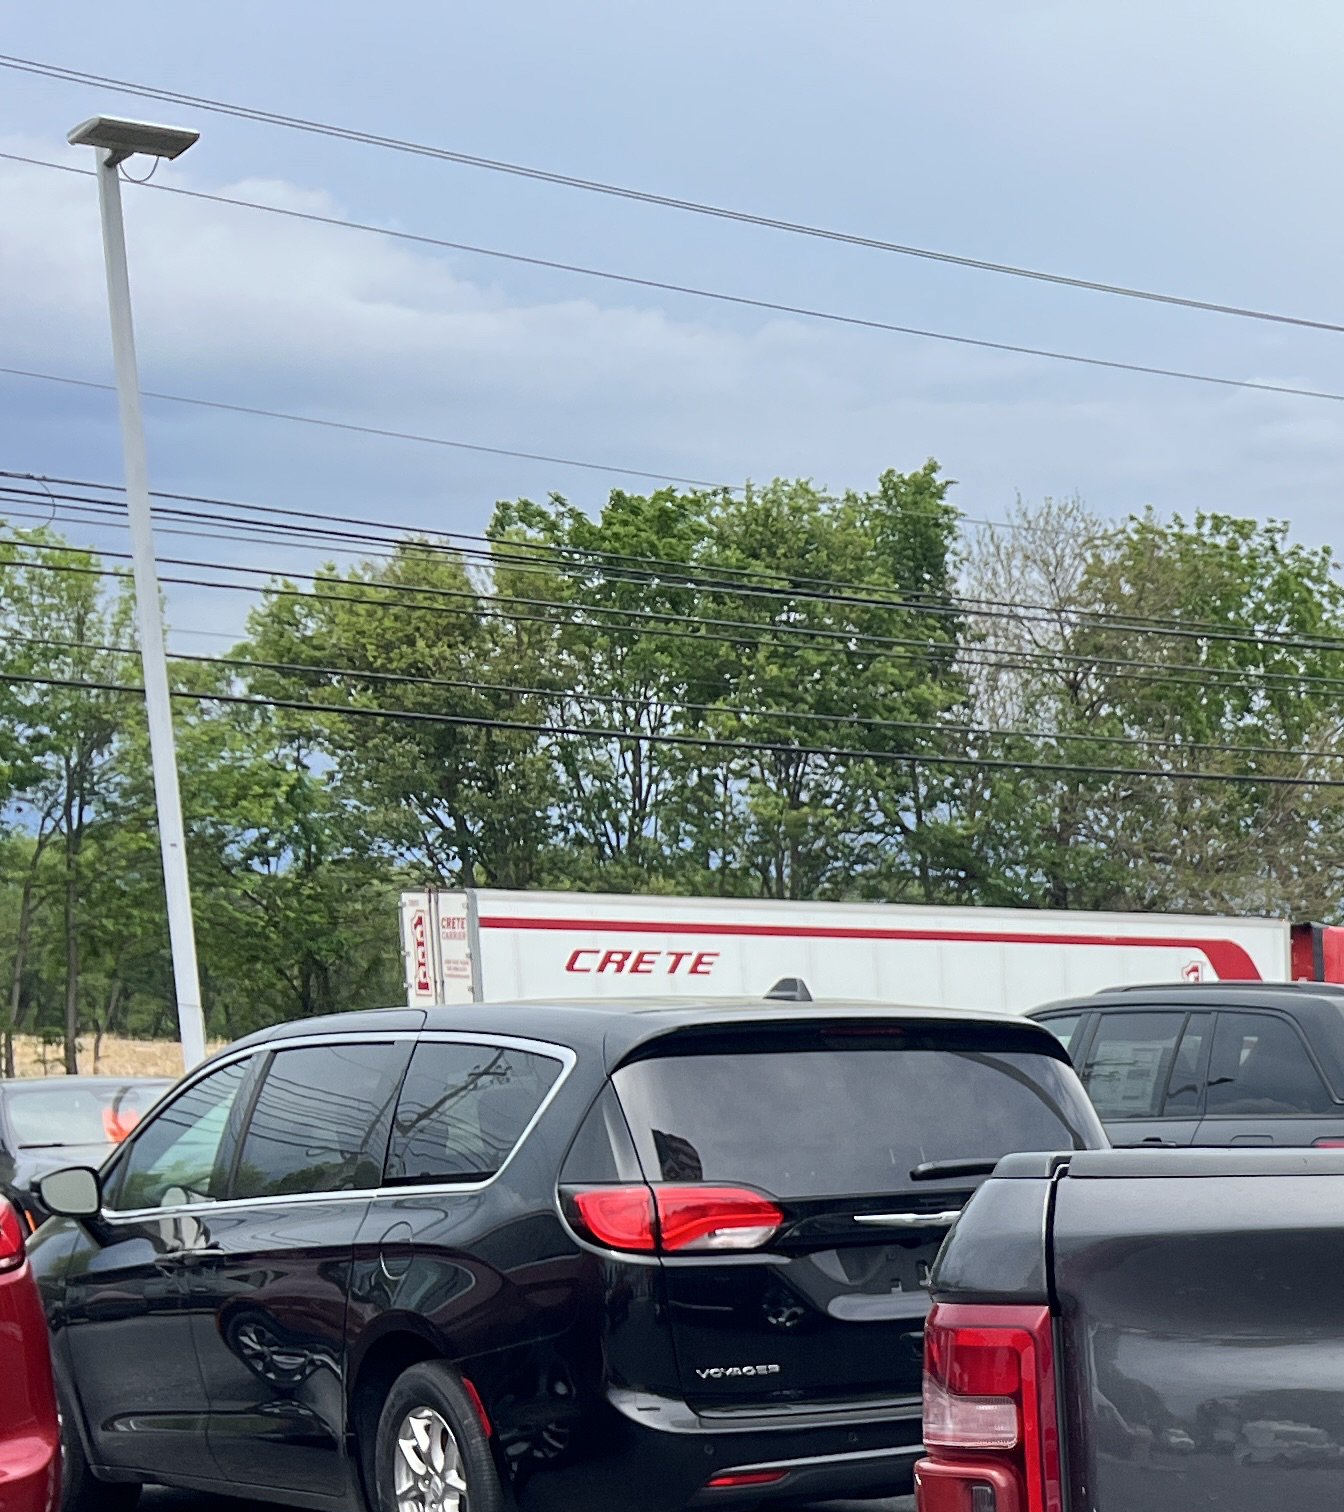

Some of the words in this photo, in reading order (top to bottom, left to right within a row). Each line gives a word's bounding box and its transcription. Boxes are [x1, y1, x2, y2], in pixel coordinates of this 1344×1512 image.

[441, 917, 466, 930] CRETE
[565, 949, 720, 975] CRETE
[695, 1364, 780, 1379] VOYAGER
